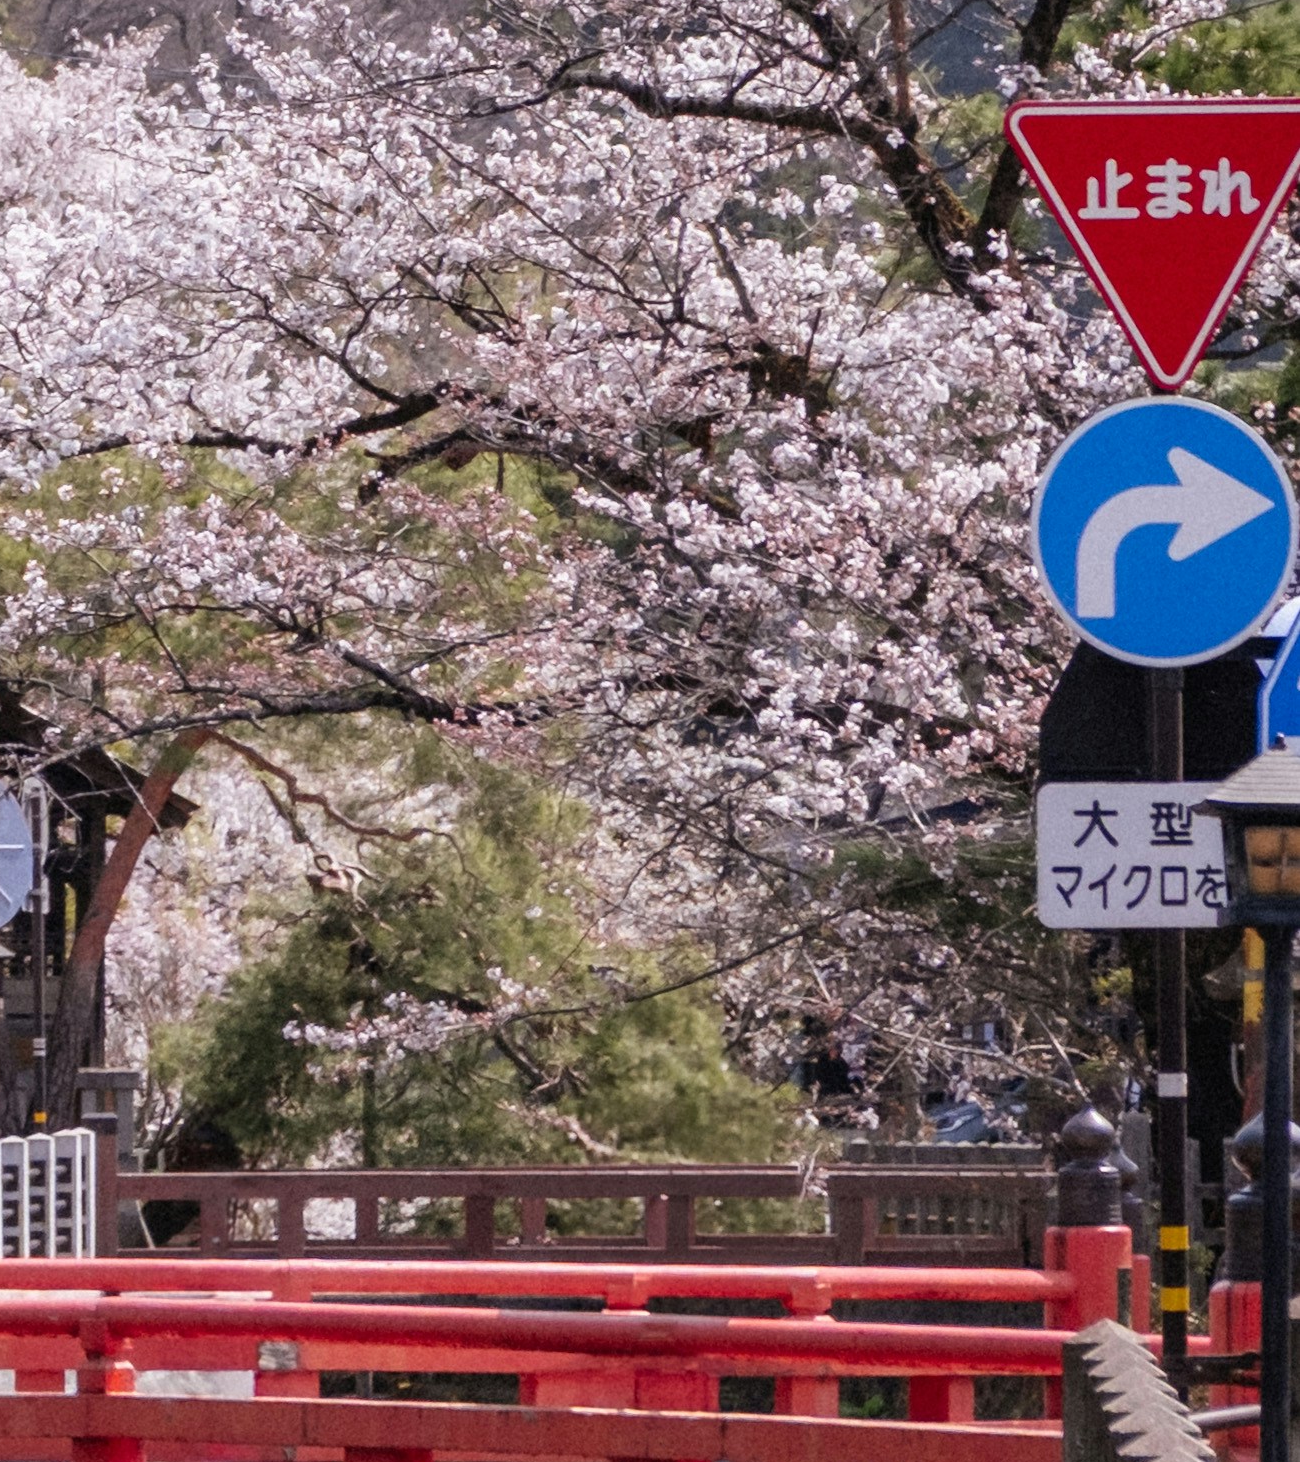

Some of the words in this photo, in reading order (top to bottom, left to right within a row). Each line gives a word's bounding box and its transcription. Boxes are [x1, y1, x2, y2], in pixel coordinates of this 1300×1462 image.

[1078, 157, 1261, 219] 止まれ
[1073, 799, 1194, 848] 大型
